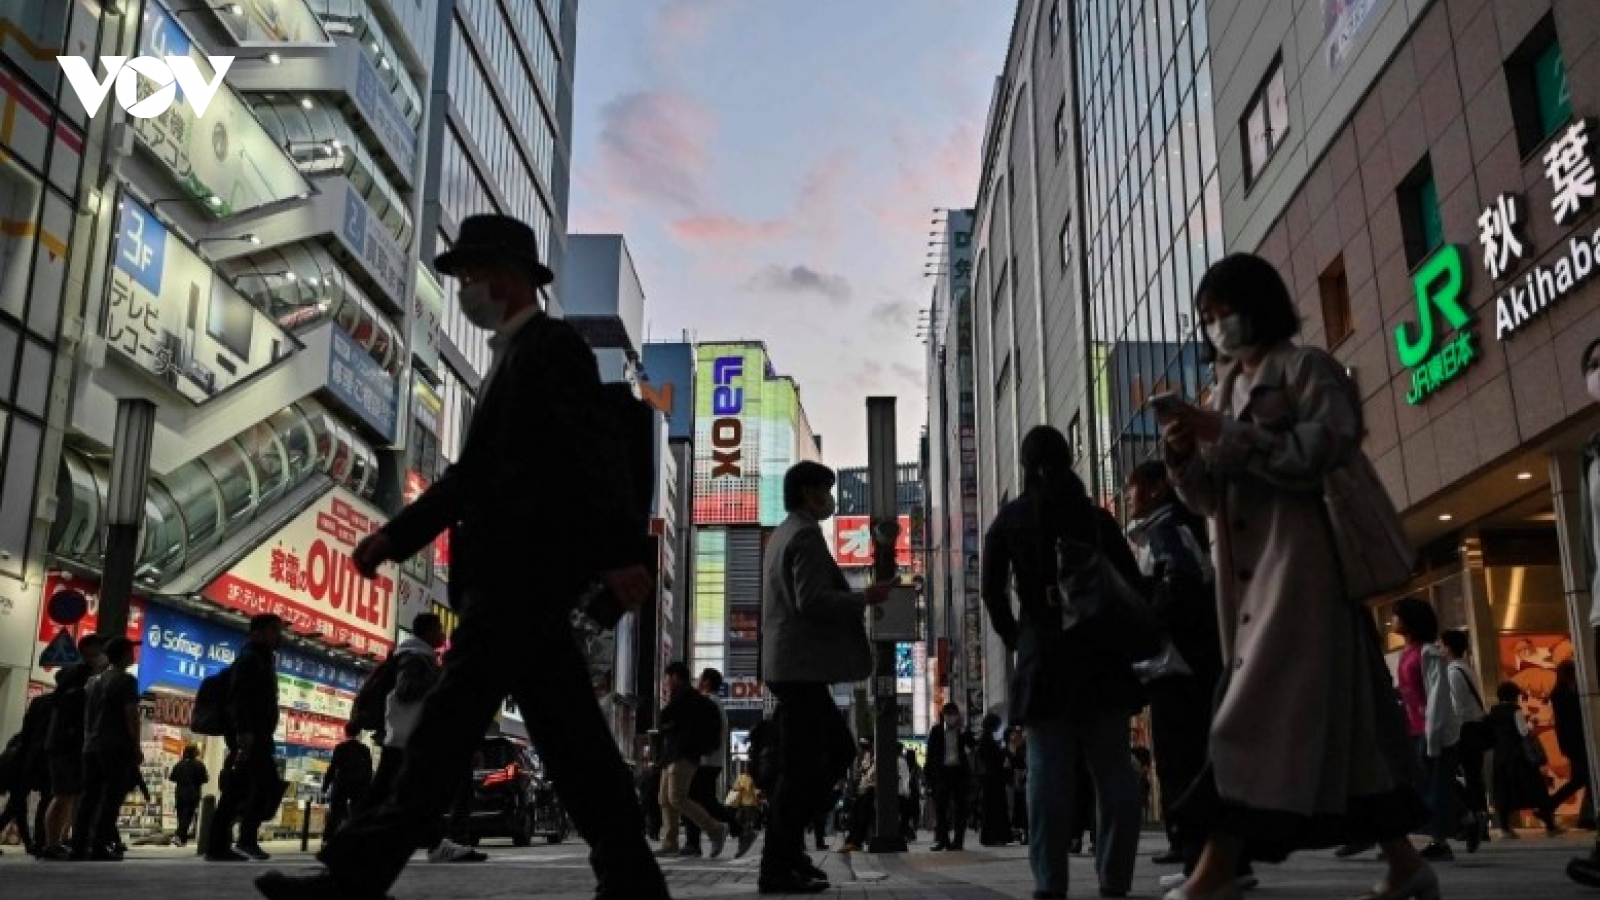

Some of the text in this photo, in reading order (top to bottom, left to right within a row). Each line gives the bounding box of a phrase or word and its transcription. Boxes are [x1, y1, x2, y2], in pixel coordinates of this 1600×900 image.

[123, 209, 153, 271] 3F
[113, 279, 159, 334] テレビ
[1395, 243, 1470, 367] JR
[1406, 331, 1474, 406] JR東日本
[307, 539, 394, 630] OUTLET
[163, 630, 203, 661] Sofmap
